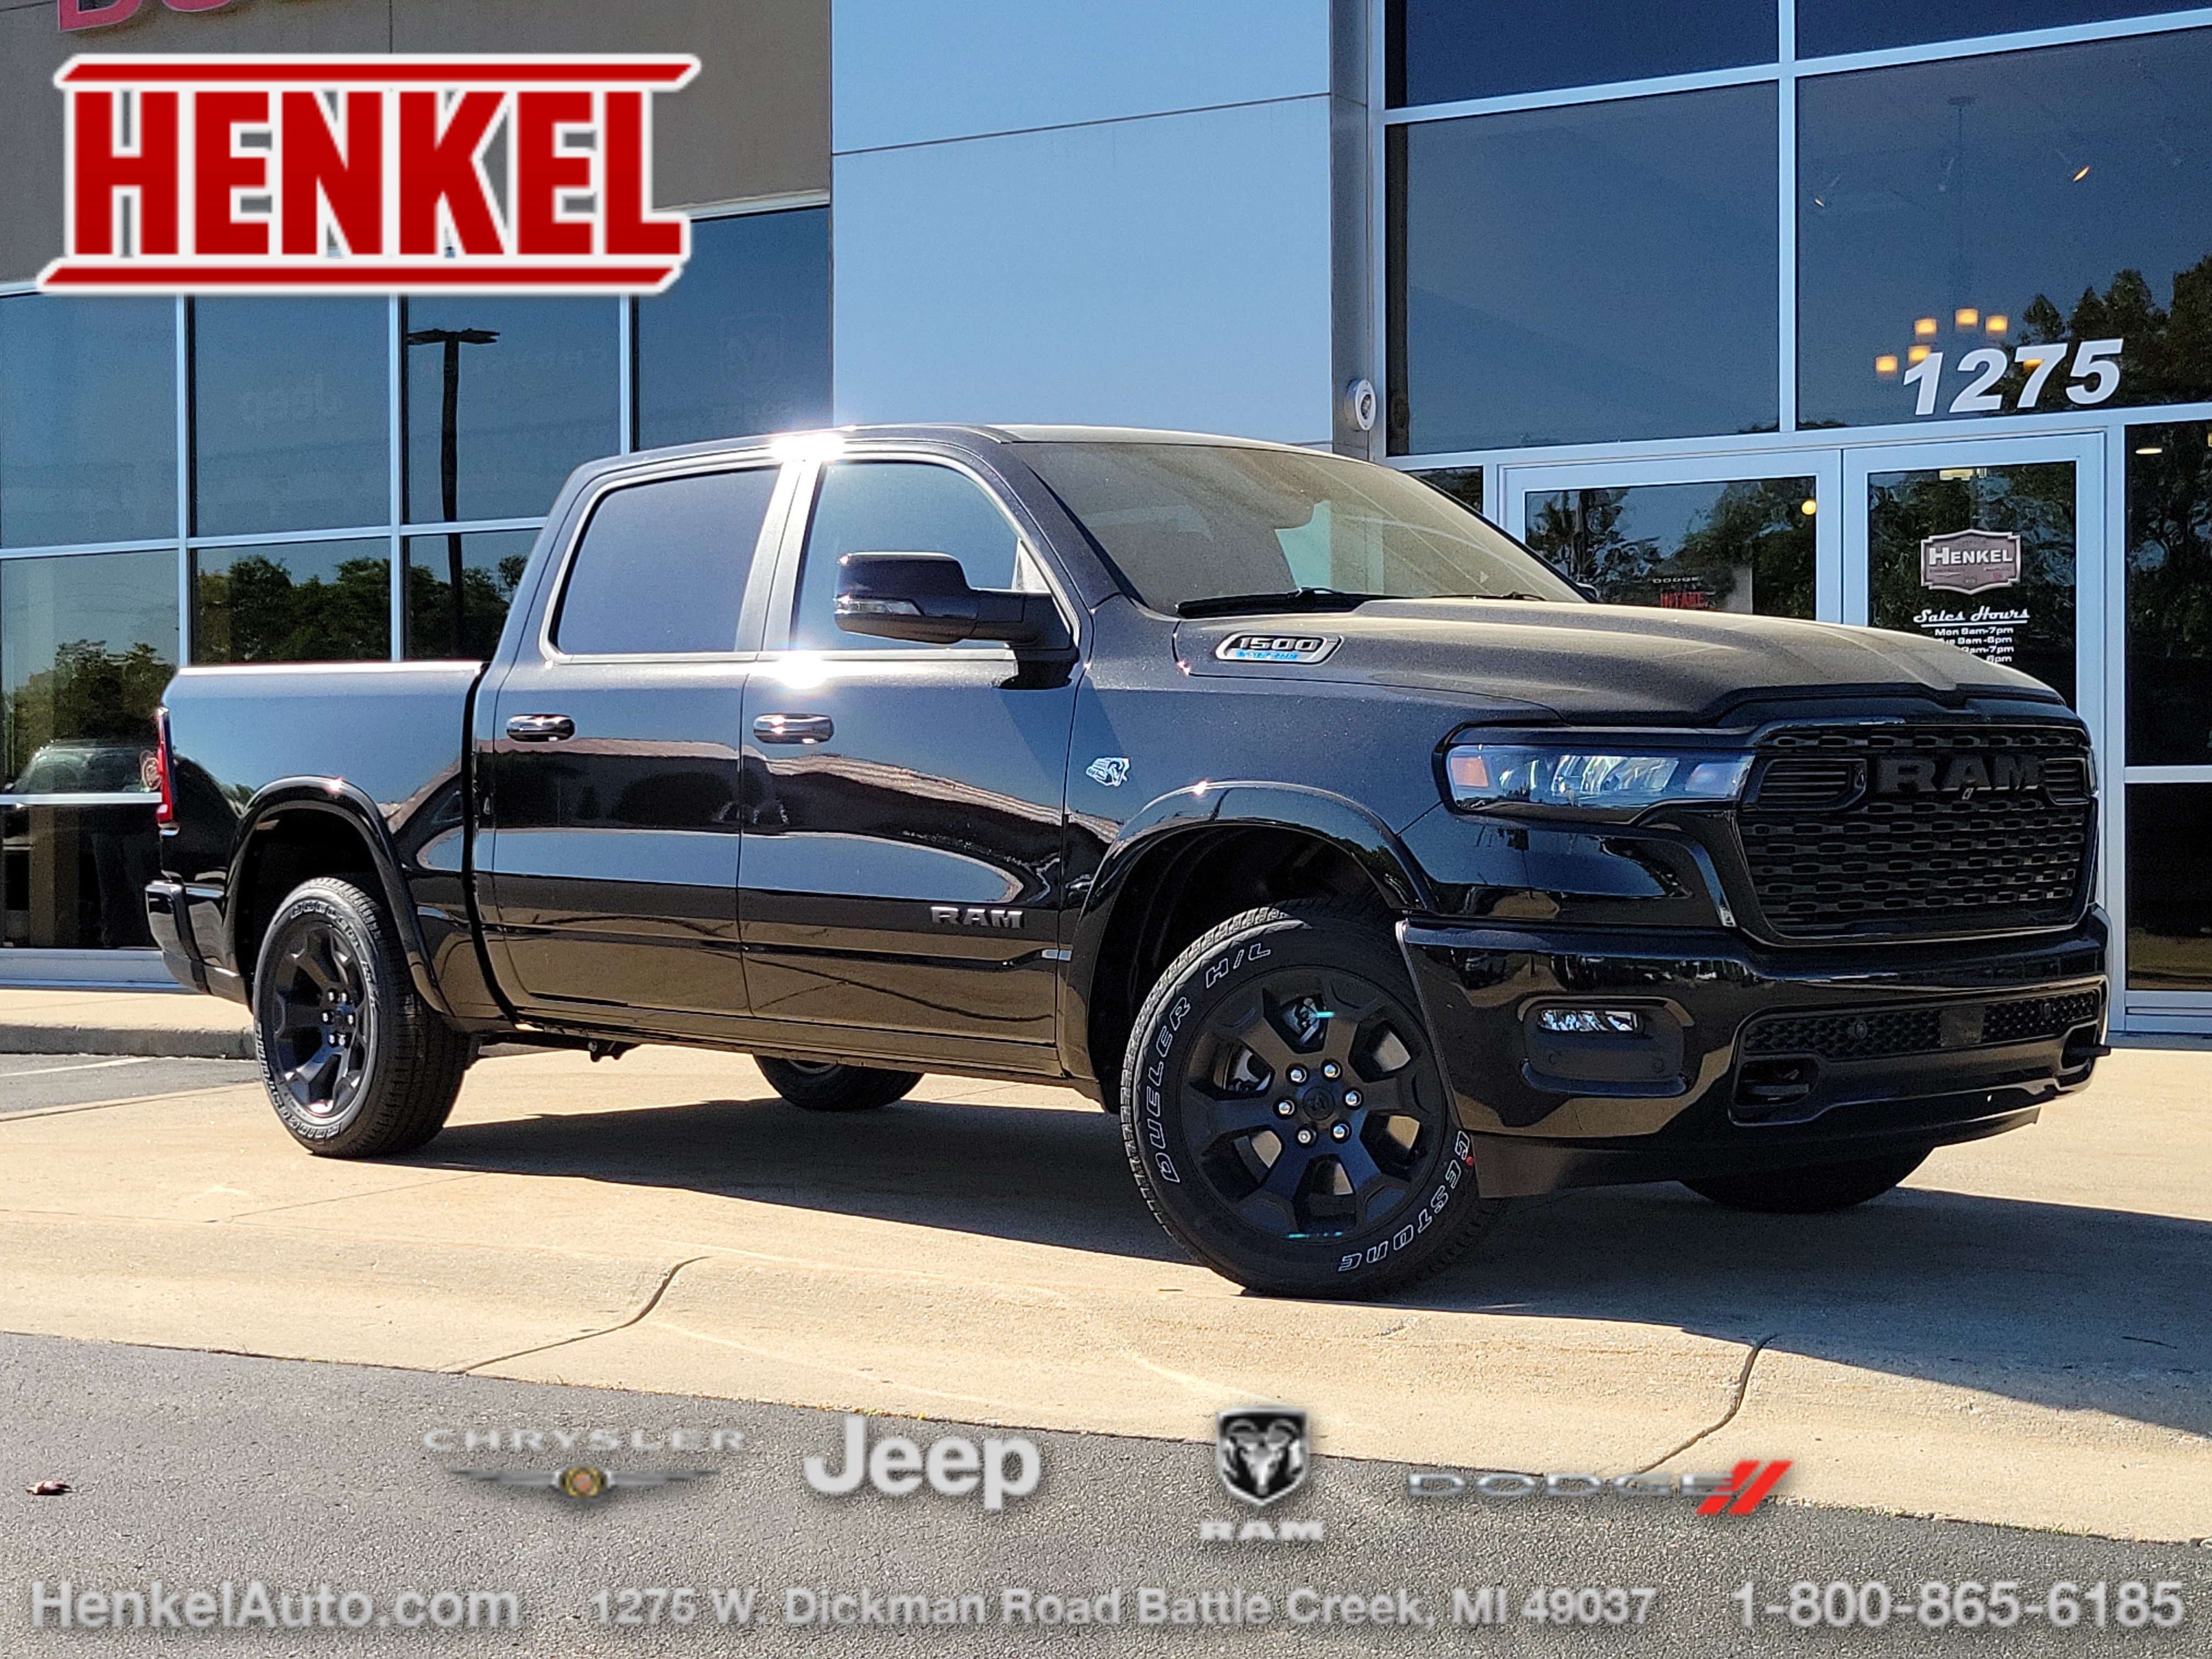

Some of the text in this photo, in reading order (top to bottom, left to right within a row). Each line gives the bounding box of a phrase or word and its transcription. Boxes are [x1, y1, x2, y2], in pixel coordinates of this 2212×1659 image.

[1903, 338, 2124, 416] 1275
[1929, 547, 2013, 565] HENKEL
[1913, 605, 2030, 623] Sales Hours
[1240, 637, 1320, 651] 1500
[1877, 755, 2038, 792] RAM
[931, 906, 1023, 928] RAM
[1146, 943, 1271, 1183] DUELER H/L
